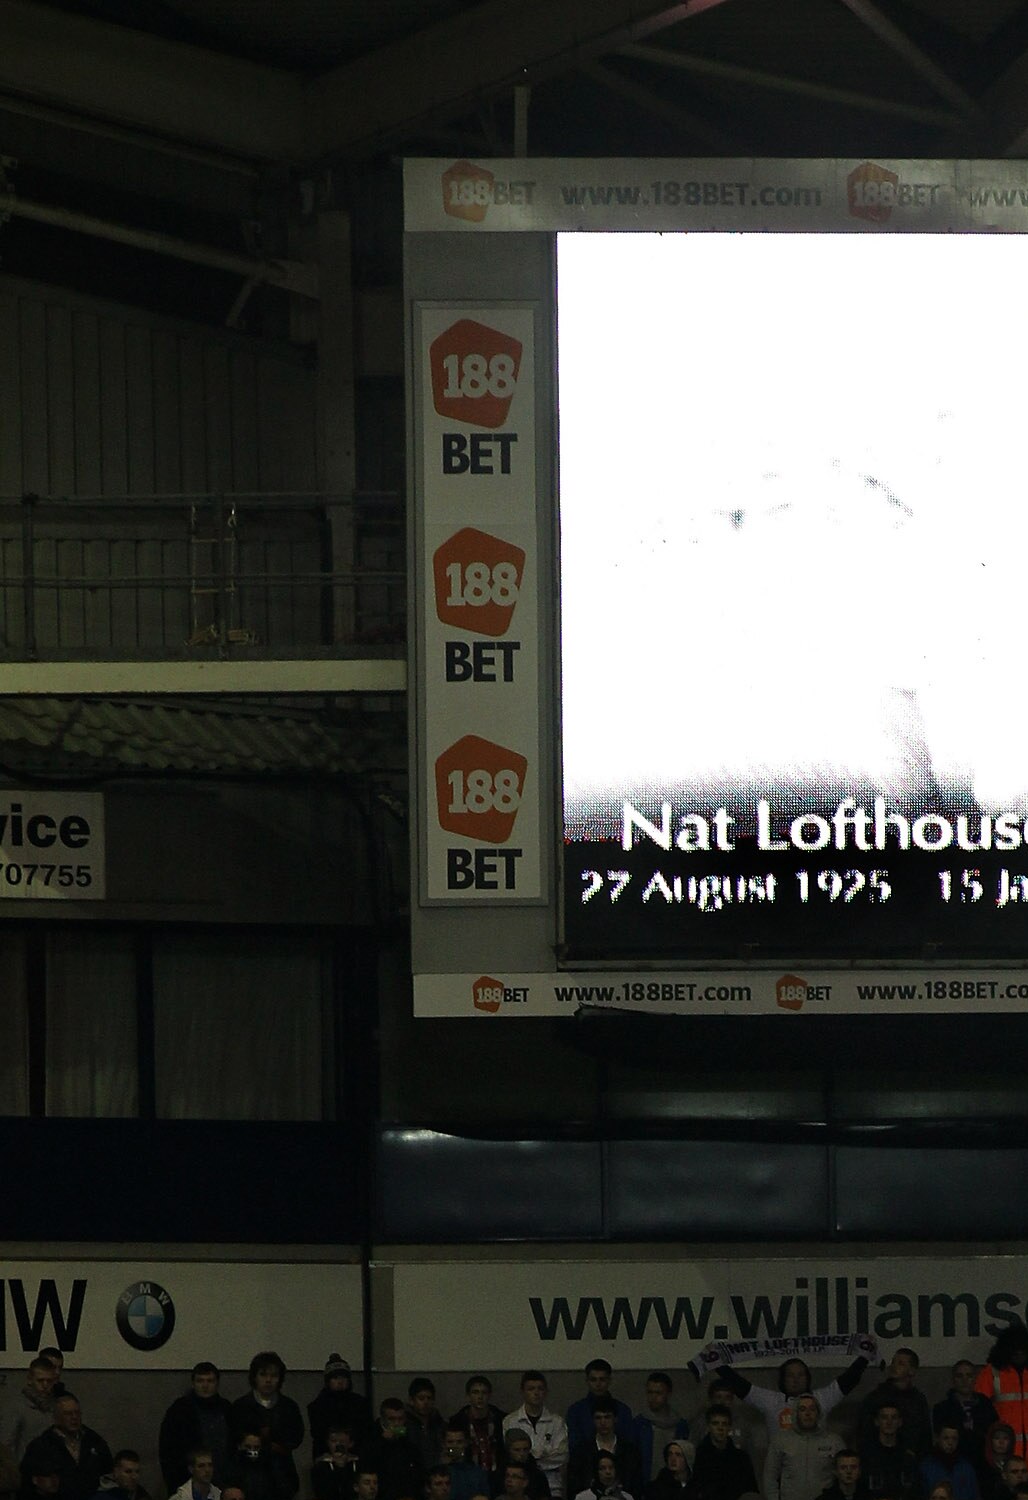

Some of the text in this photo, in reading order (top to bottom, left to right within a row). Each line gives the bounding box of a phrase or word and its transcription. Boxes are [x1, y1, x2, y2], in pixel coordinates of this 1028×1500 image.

[560, 180, 822, 209] www.188BET.com
[443, 354, 516, 399] 188
[442, 434, 518, 475] BET
[446, 563, 518, 608] 188
[446, 641, 520, 683] BET
[447, 769, 520, 814] 188
[0, 804, 91, 848] ice
[621, 801, 735, 851] Nat
[447, 849, 522, 891] BET
[581, 869, 632, 903] 27
[641, 869, 777, 911] August
[796, 869, 891, 903] 1925
[938, 869, 983, 903] 15
[554, 983, 752, 1003] www.188BET.com
[0, 1279, 87, 1352] W
